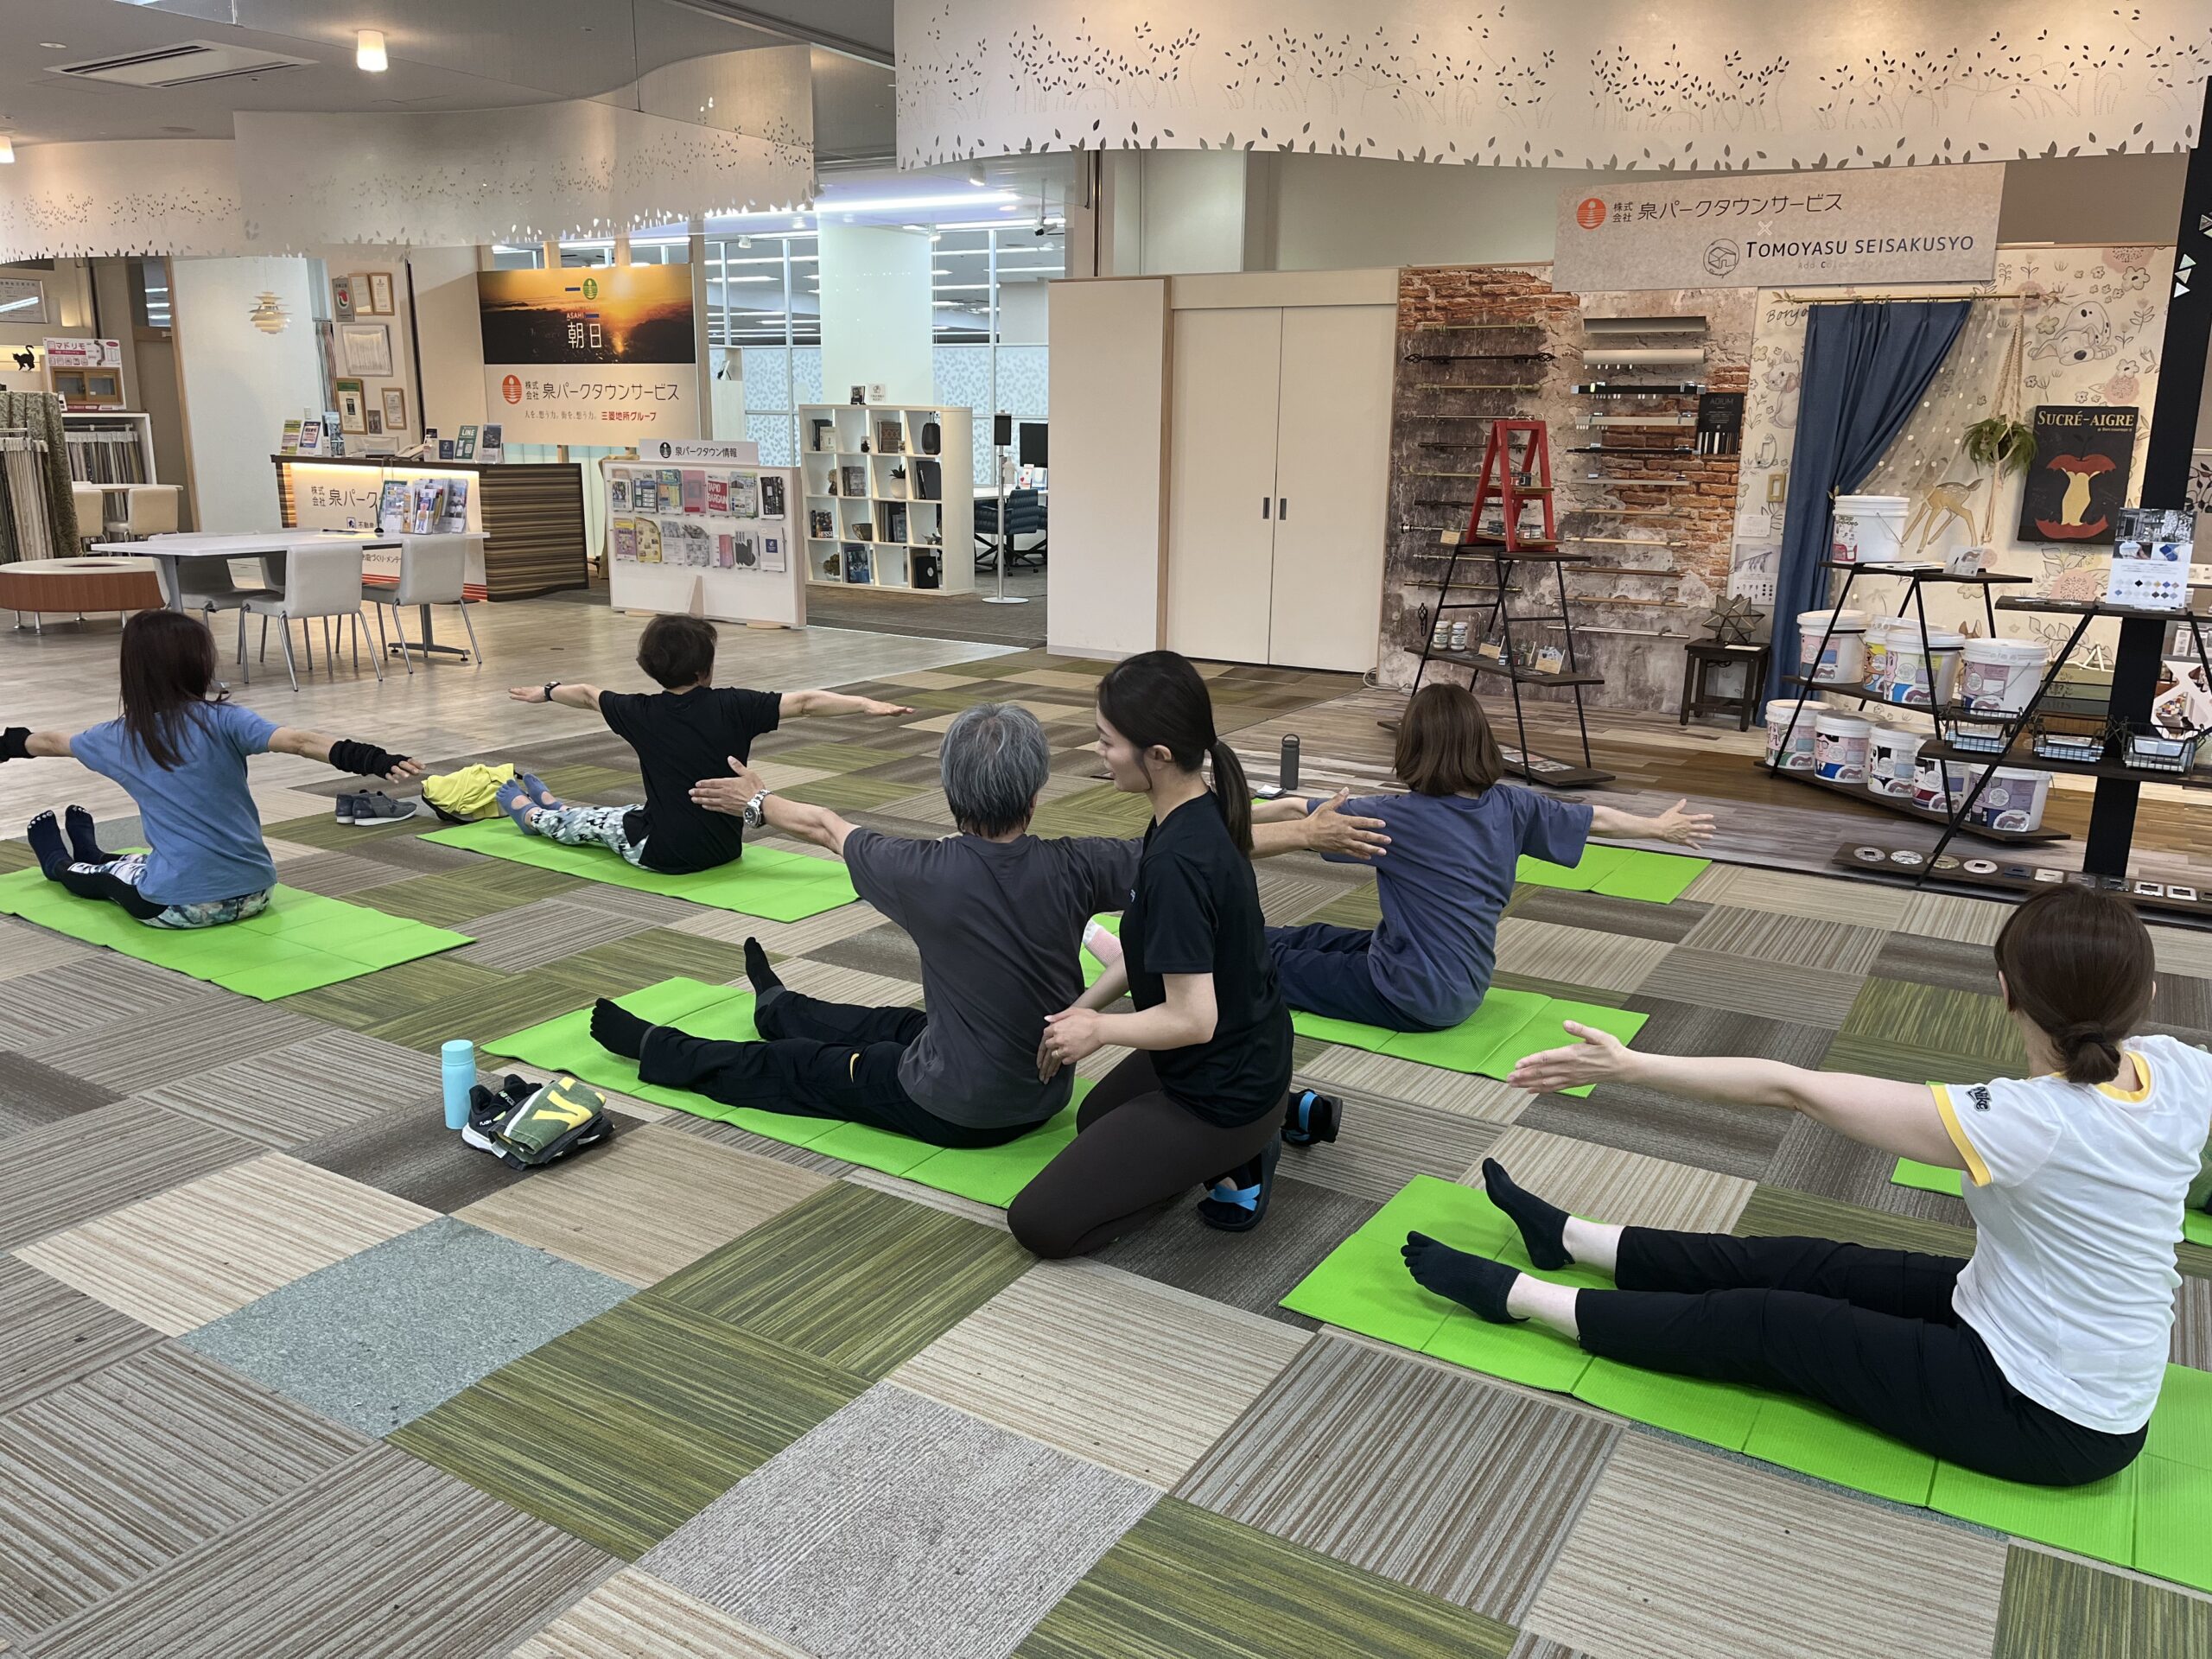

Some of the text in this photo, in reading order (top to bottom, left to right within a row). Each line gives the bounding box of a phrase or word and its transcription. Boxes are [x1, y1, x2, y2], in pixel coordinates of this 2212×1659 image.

[1613, 201, 1633, 212] 株式
[1637, 194, 1843, 220] 泉パークタウンサービス
[1612, 213, 1632, 223] 会社
[1746, 236, 1974, 257] TOMOYASU SEISAKUSYO
[567, 321, 602, 349] 朝日
[525, 381, 539, 390] 株式
[543, 381, 679, 401] 泉パークタウンサービス
[526, 391, 540, 400] 会社
[601, 411, 657, 422] 三菱地所グループ
[2037, 410, 2134, 427] SUCRÉ-AIGRE
[675, 446, 737, 458] 泉パークタウン情報
[311, 486, 325, 496] 株式
[312, 497, 326, 506] 会社
